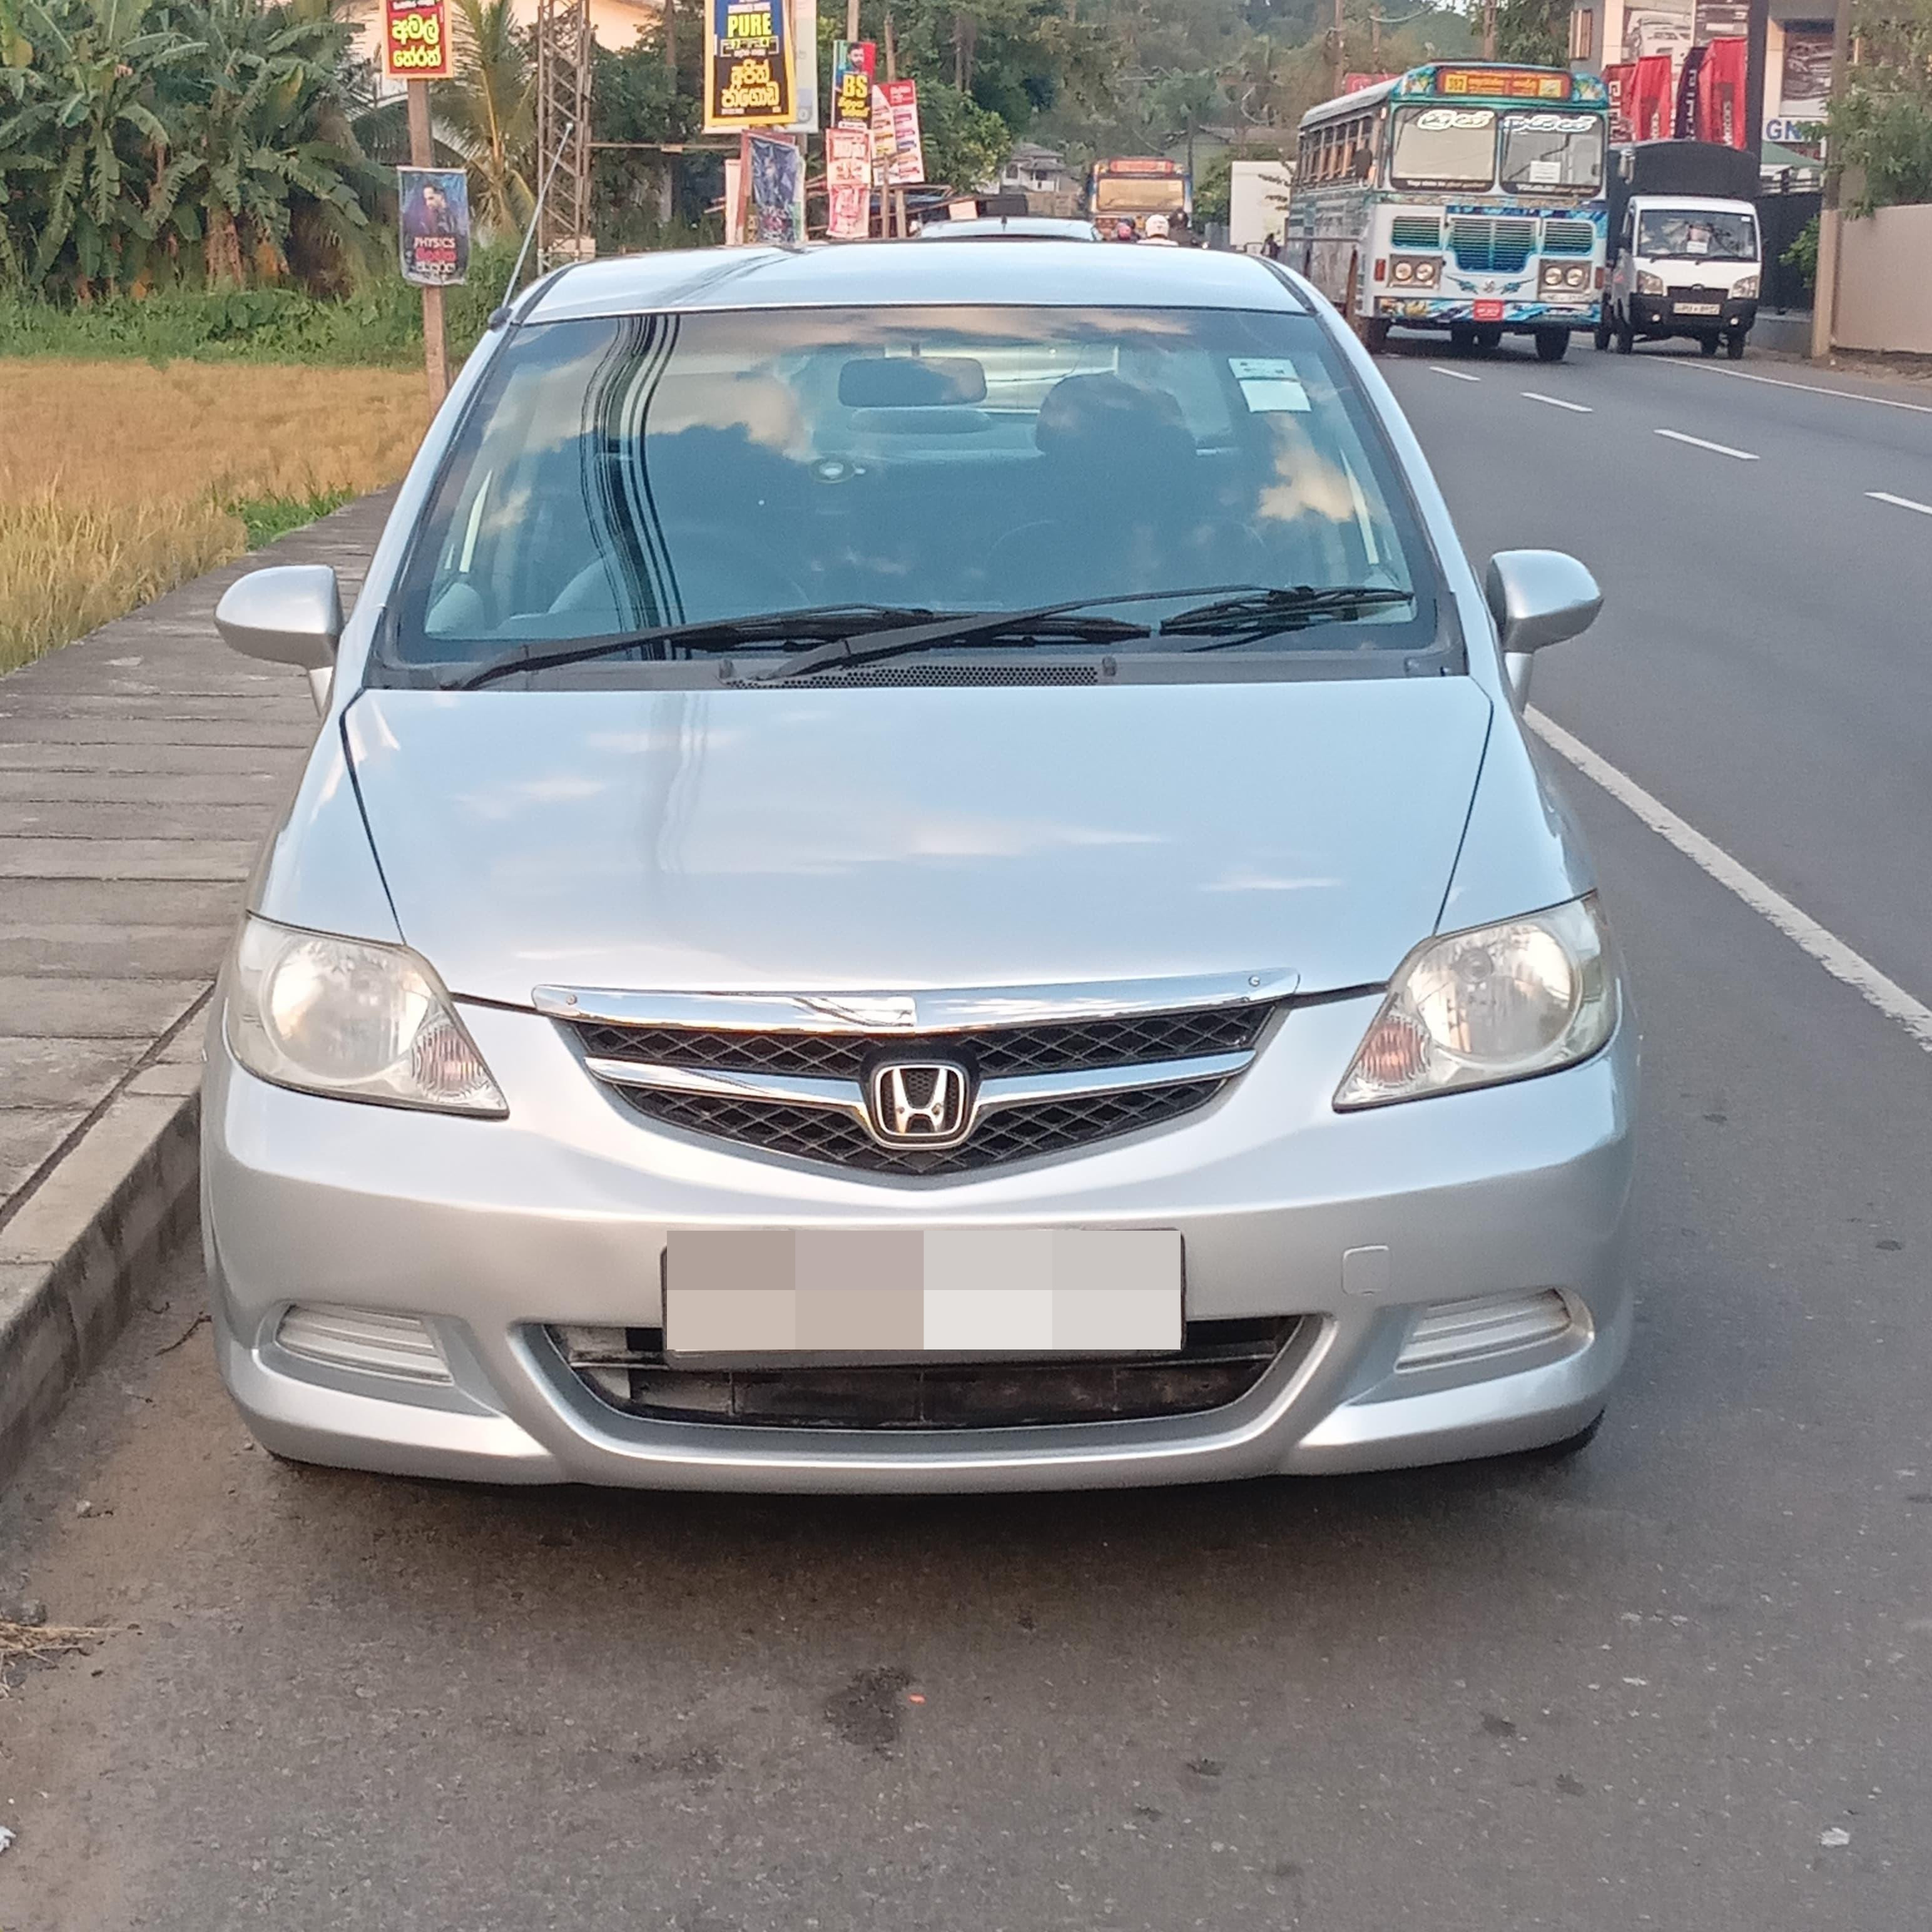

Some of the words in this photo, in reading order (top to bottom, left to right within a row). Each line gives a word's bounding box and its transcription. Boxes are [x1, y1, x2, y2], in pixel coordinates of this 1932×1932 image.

[392, 14, 440, 45] අමල්
[728, 13, 772, 38] PURE
[843, 74, 868, 99] BS
